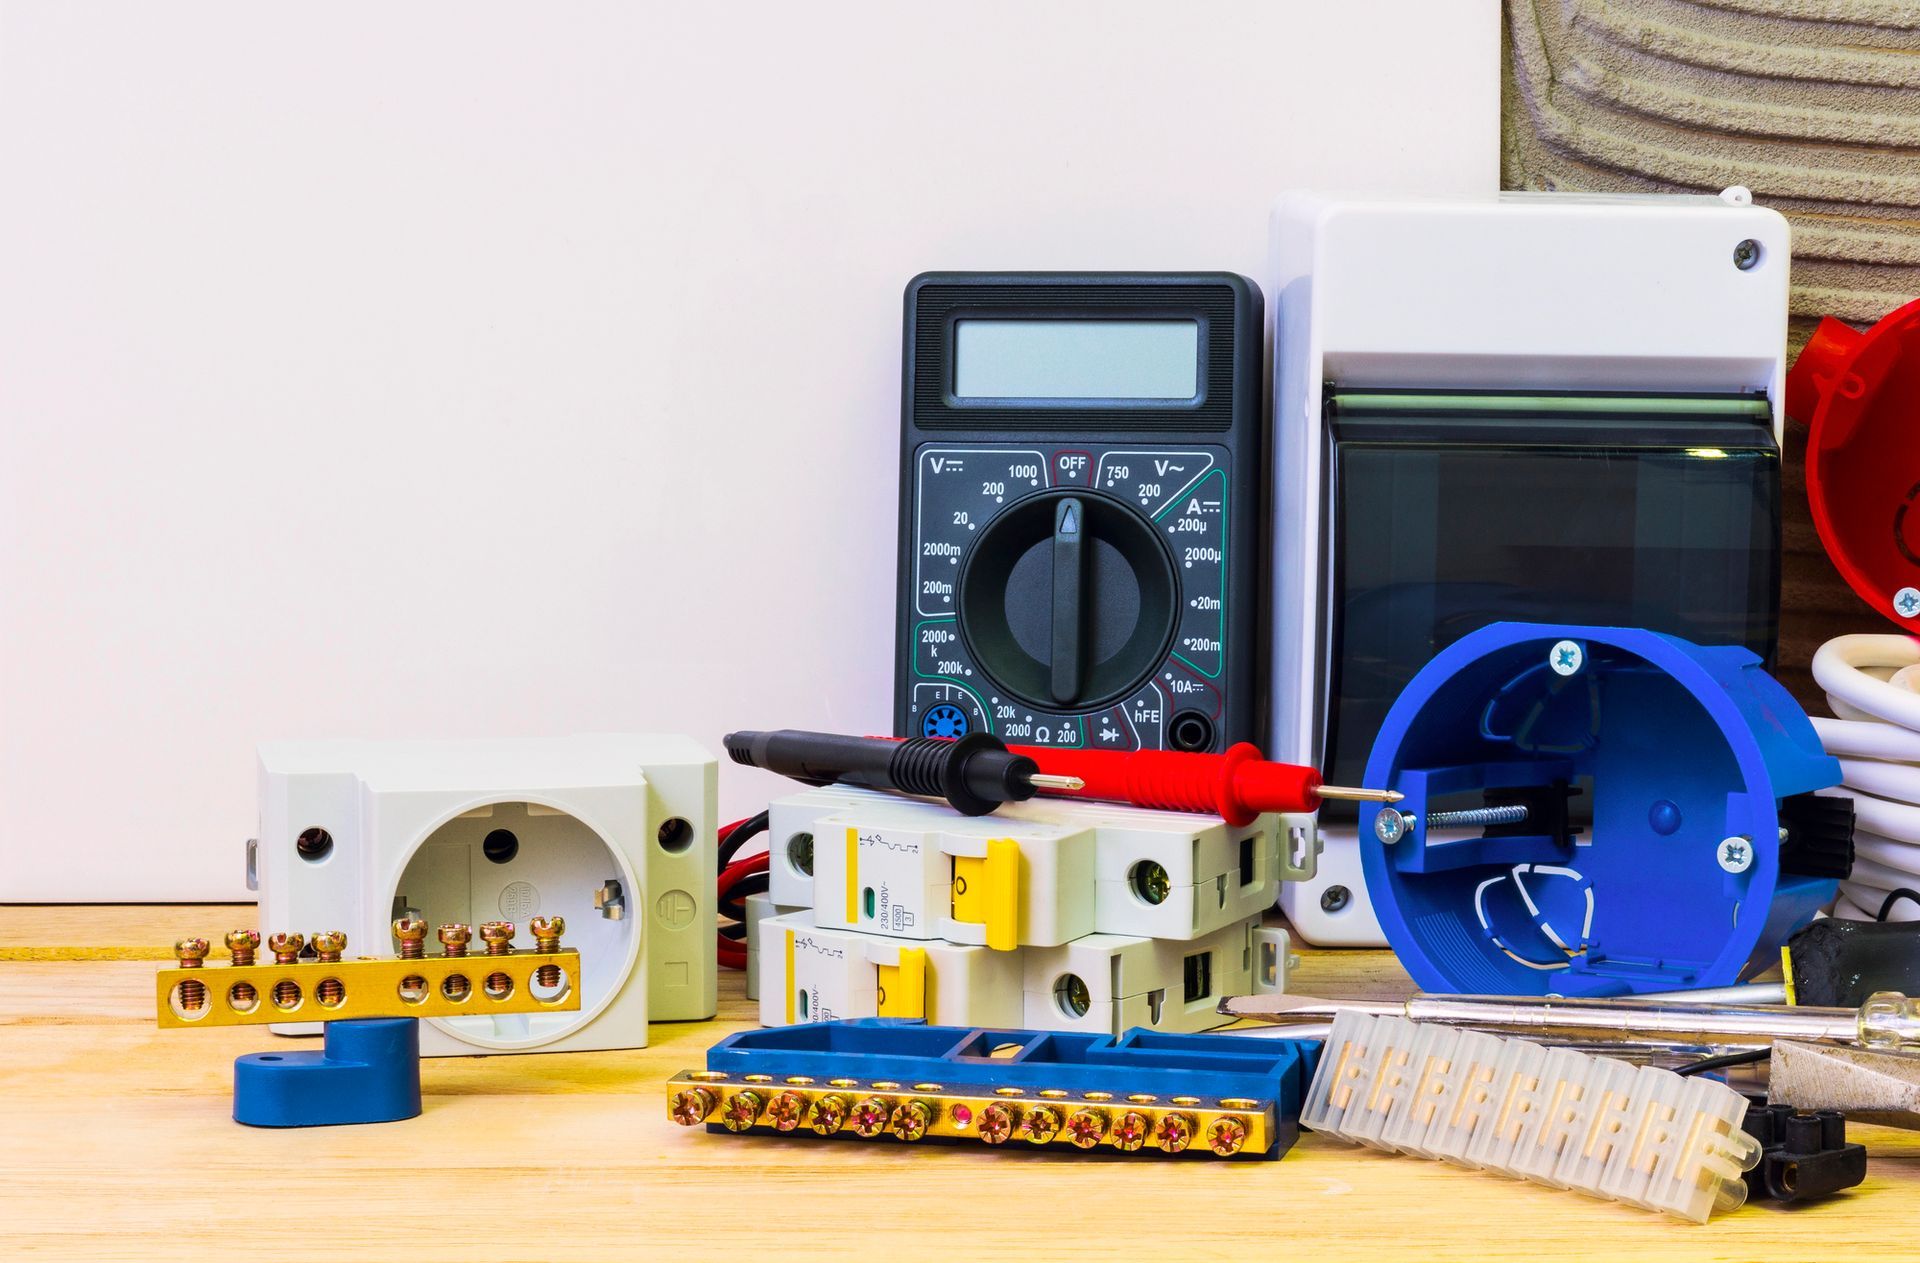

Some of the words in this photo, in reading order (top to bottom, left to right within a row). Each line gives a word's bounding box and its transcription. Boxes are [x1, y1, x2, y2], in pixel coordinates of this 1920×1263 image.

[1060, 456, 1086, 470] OFF
[1009, 465, 1038, 478] 1000
[1107, 466, 1129, 479] 750
[982, 482, 1004, 495] 200
[1138, 484, 1160, 497] 200
[953, 512, 968, 525] 20
[923, 543, 961, 556] 2000m
[923, 581, 952, 594] 200m
[1197, 596, 1220, 610] 20m
[922, 630, 947, 643] 2000
[931, 645, 938, 657] k
[1190, 638, 1220, 651] 200m
[937, 661, 963, 674] 200k
[996, 705, 1016, 719] 20k
[1134, 710, 1160, 723] hFE
[1005, 724, 1031, 737] 2000
[1057, 730, 1076, 743] 200
